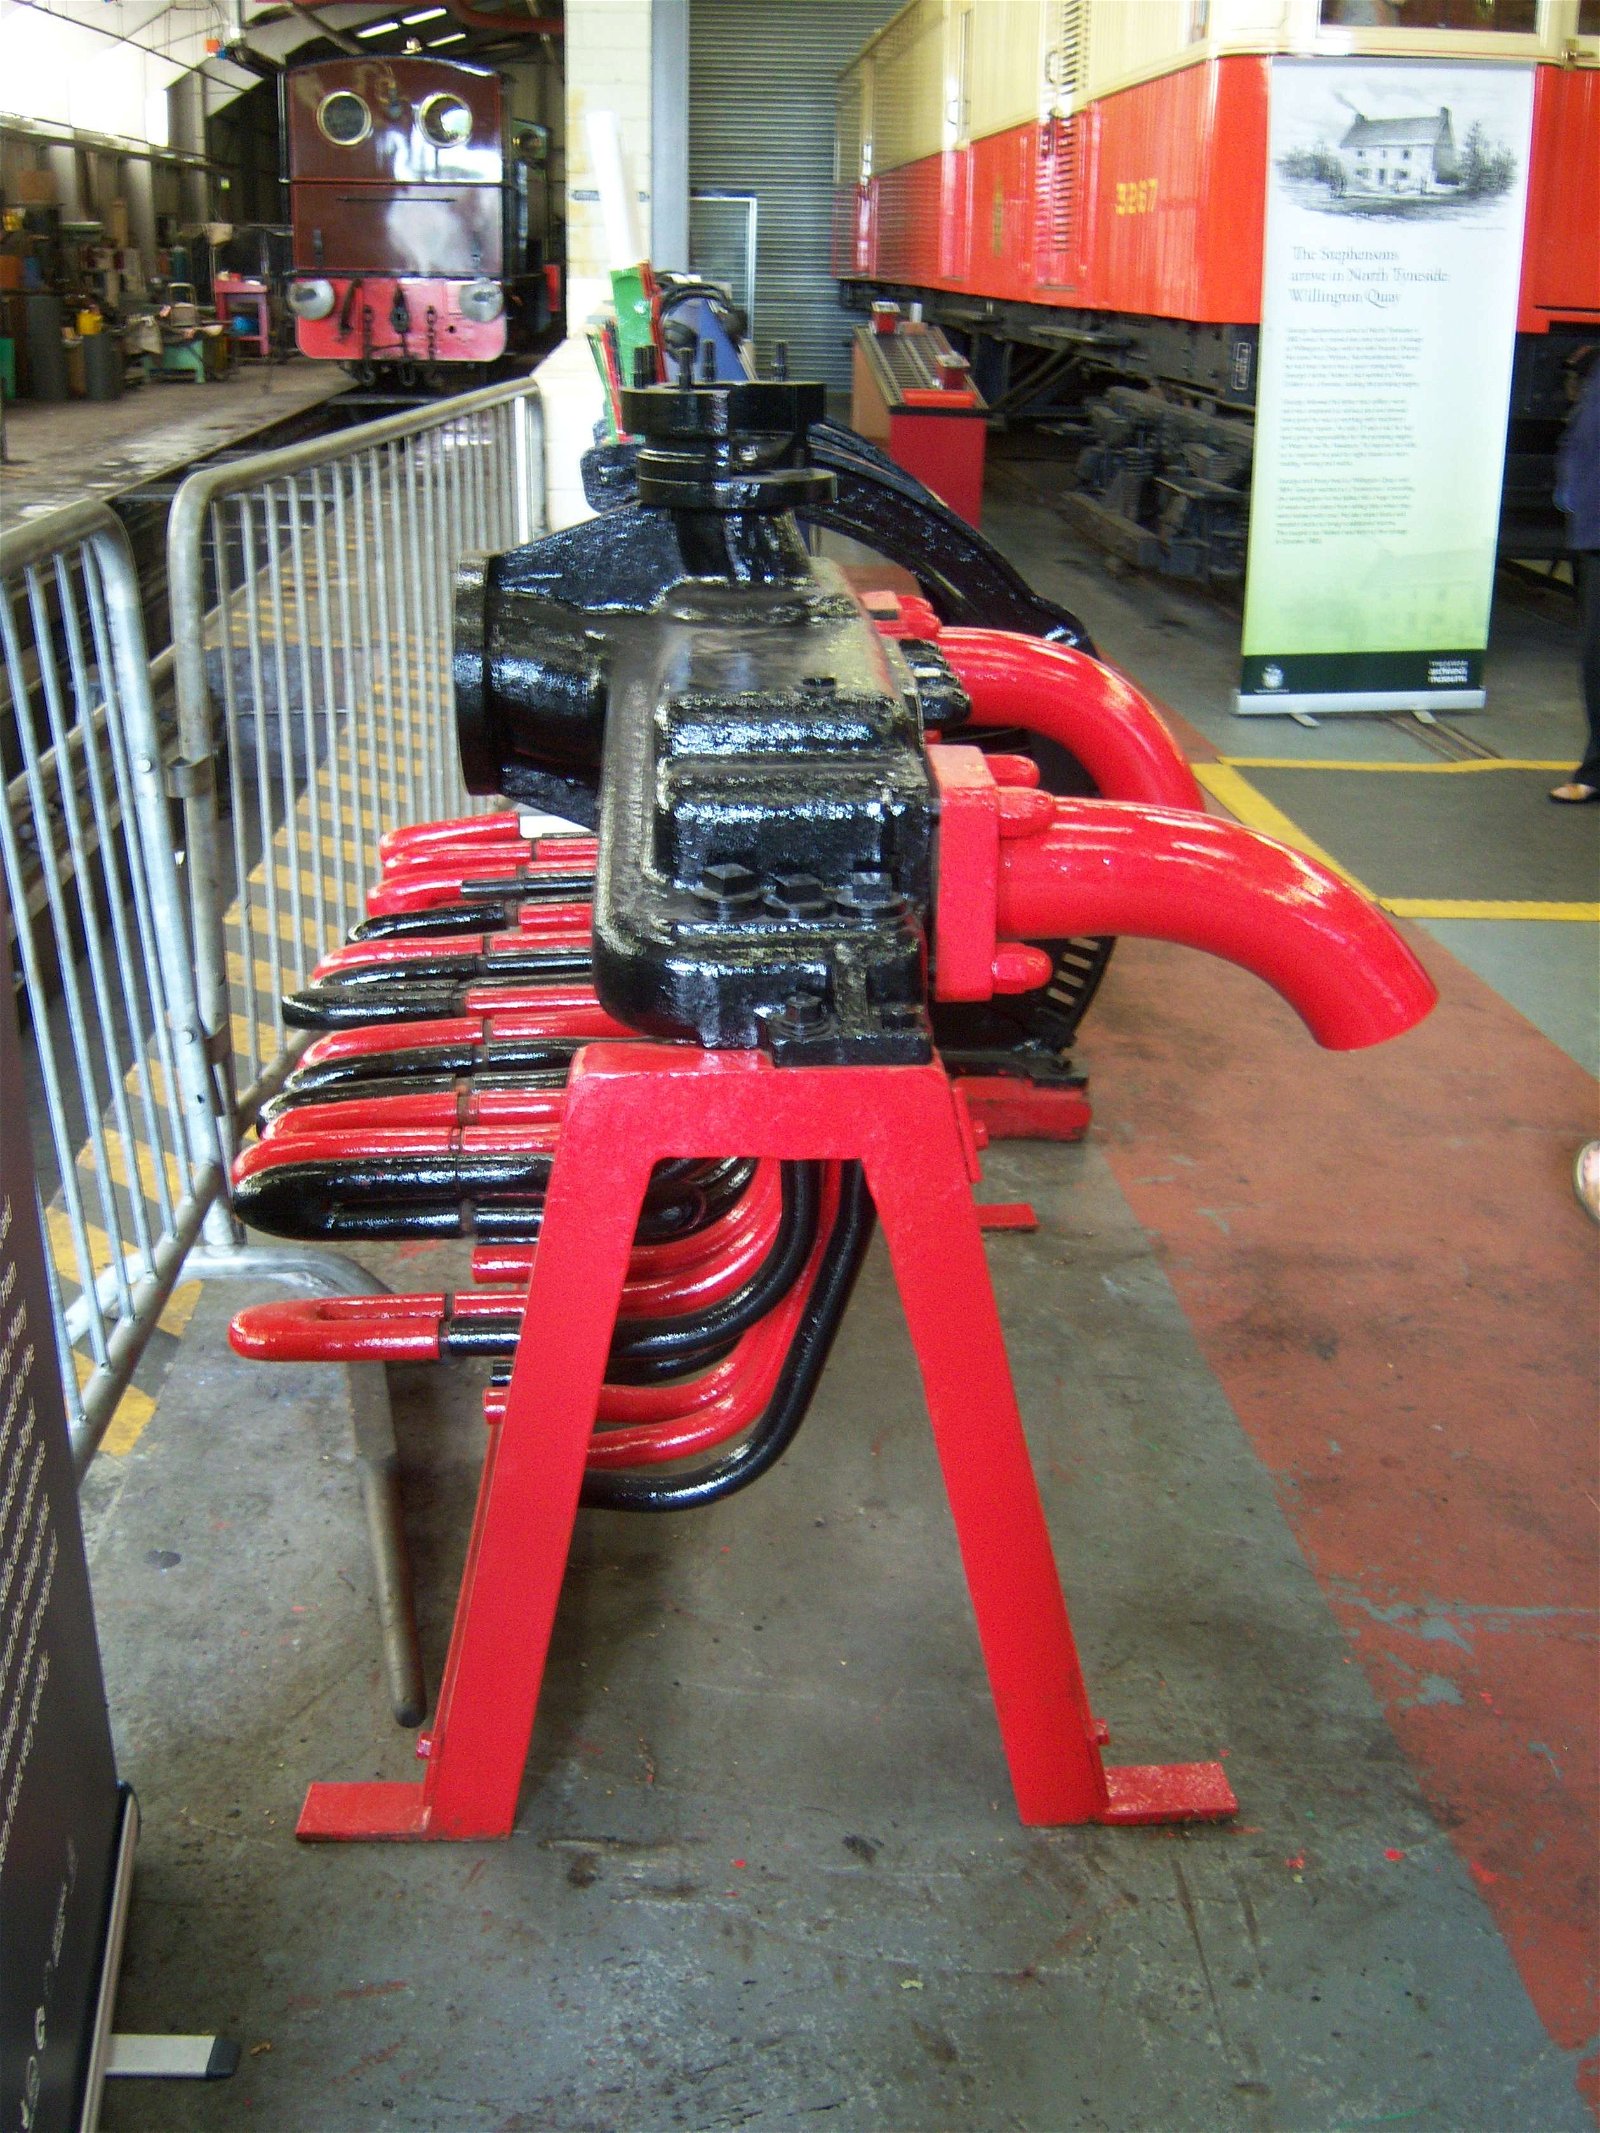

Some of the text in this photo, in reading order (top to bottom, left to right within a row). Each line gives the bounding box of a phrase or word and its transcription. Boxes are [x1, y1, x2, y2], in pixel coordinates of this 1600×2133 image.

[1293, 246, 1315, 261] The
[1348, 267, 1388, 283] North
[1392, 266, 1450, 286] Tyneside
[1288, 287, 1362, 307] Willington
